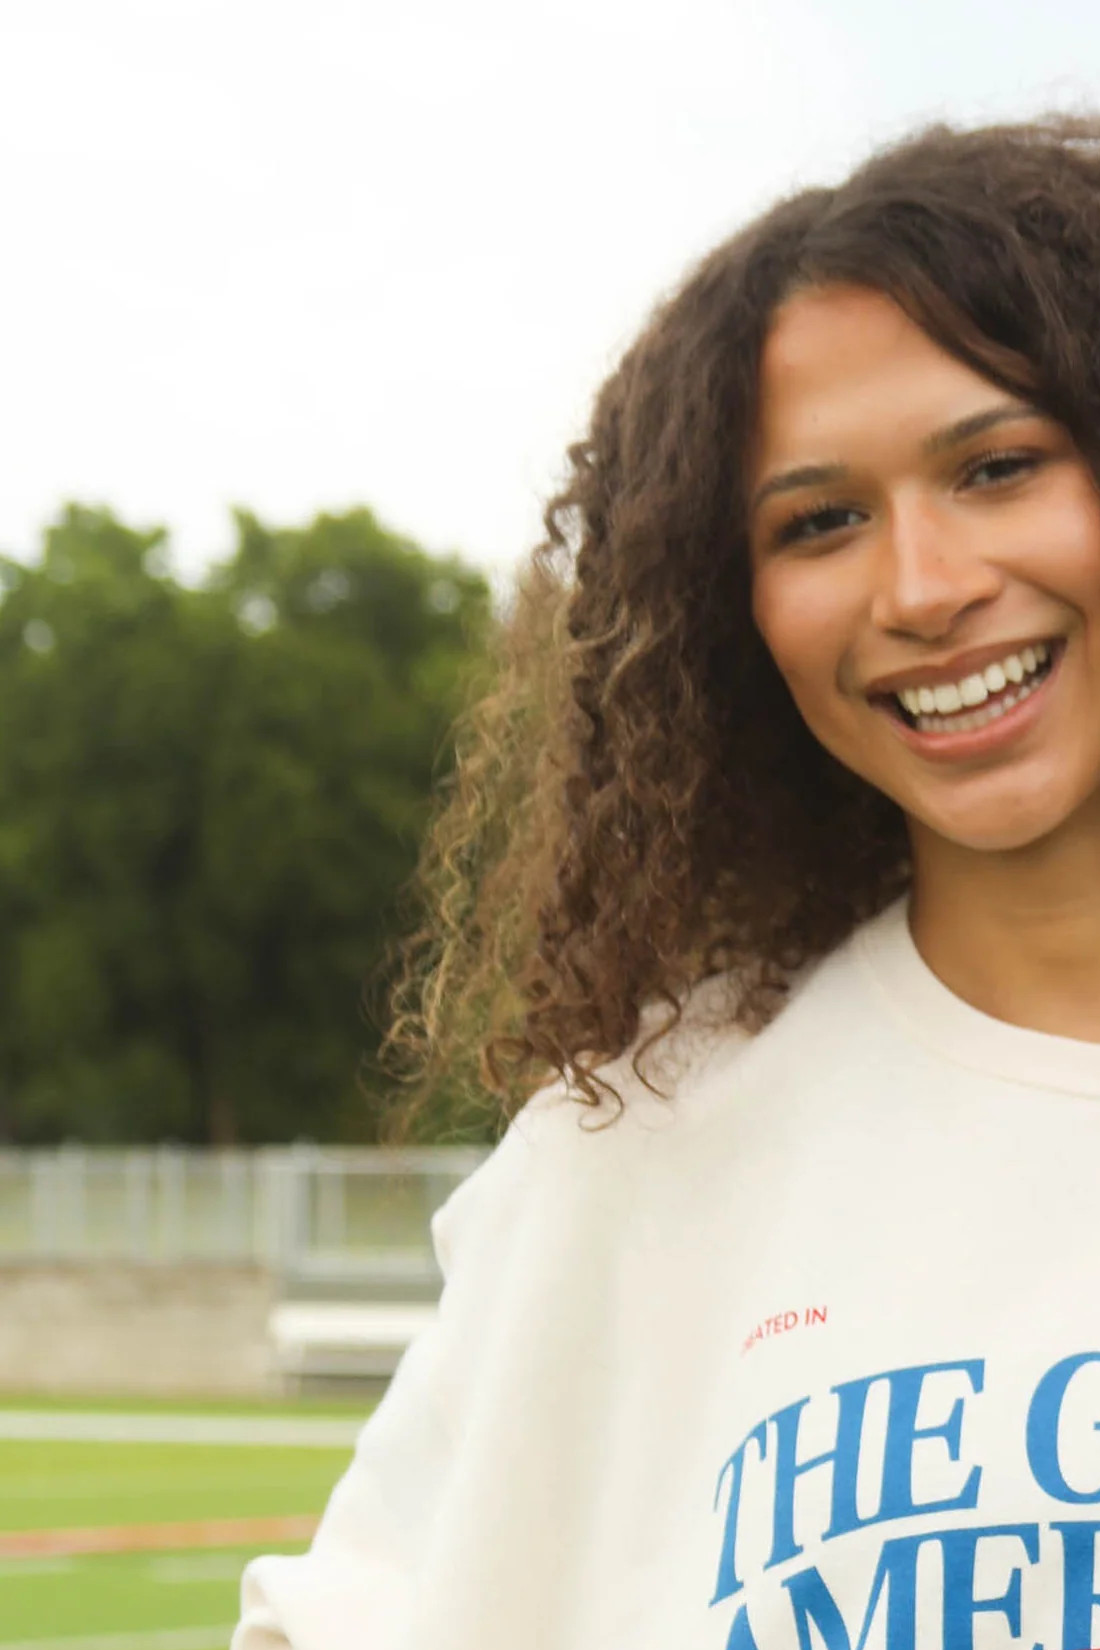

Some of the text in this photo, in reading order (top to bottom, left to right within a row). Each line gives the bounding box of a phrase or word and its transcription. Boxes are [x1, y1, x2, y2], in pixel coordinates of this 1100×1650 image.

[740, 1305, 828, 1357] ATED IN
[708, 1358, 985, 1607] THE
